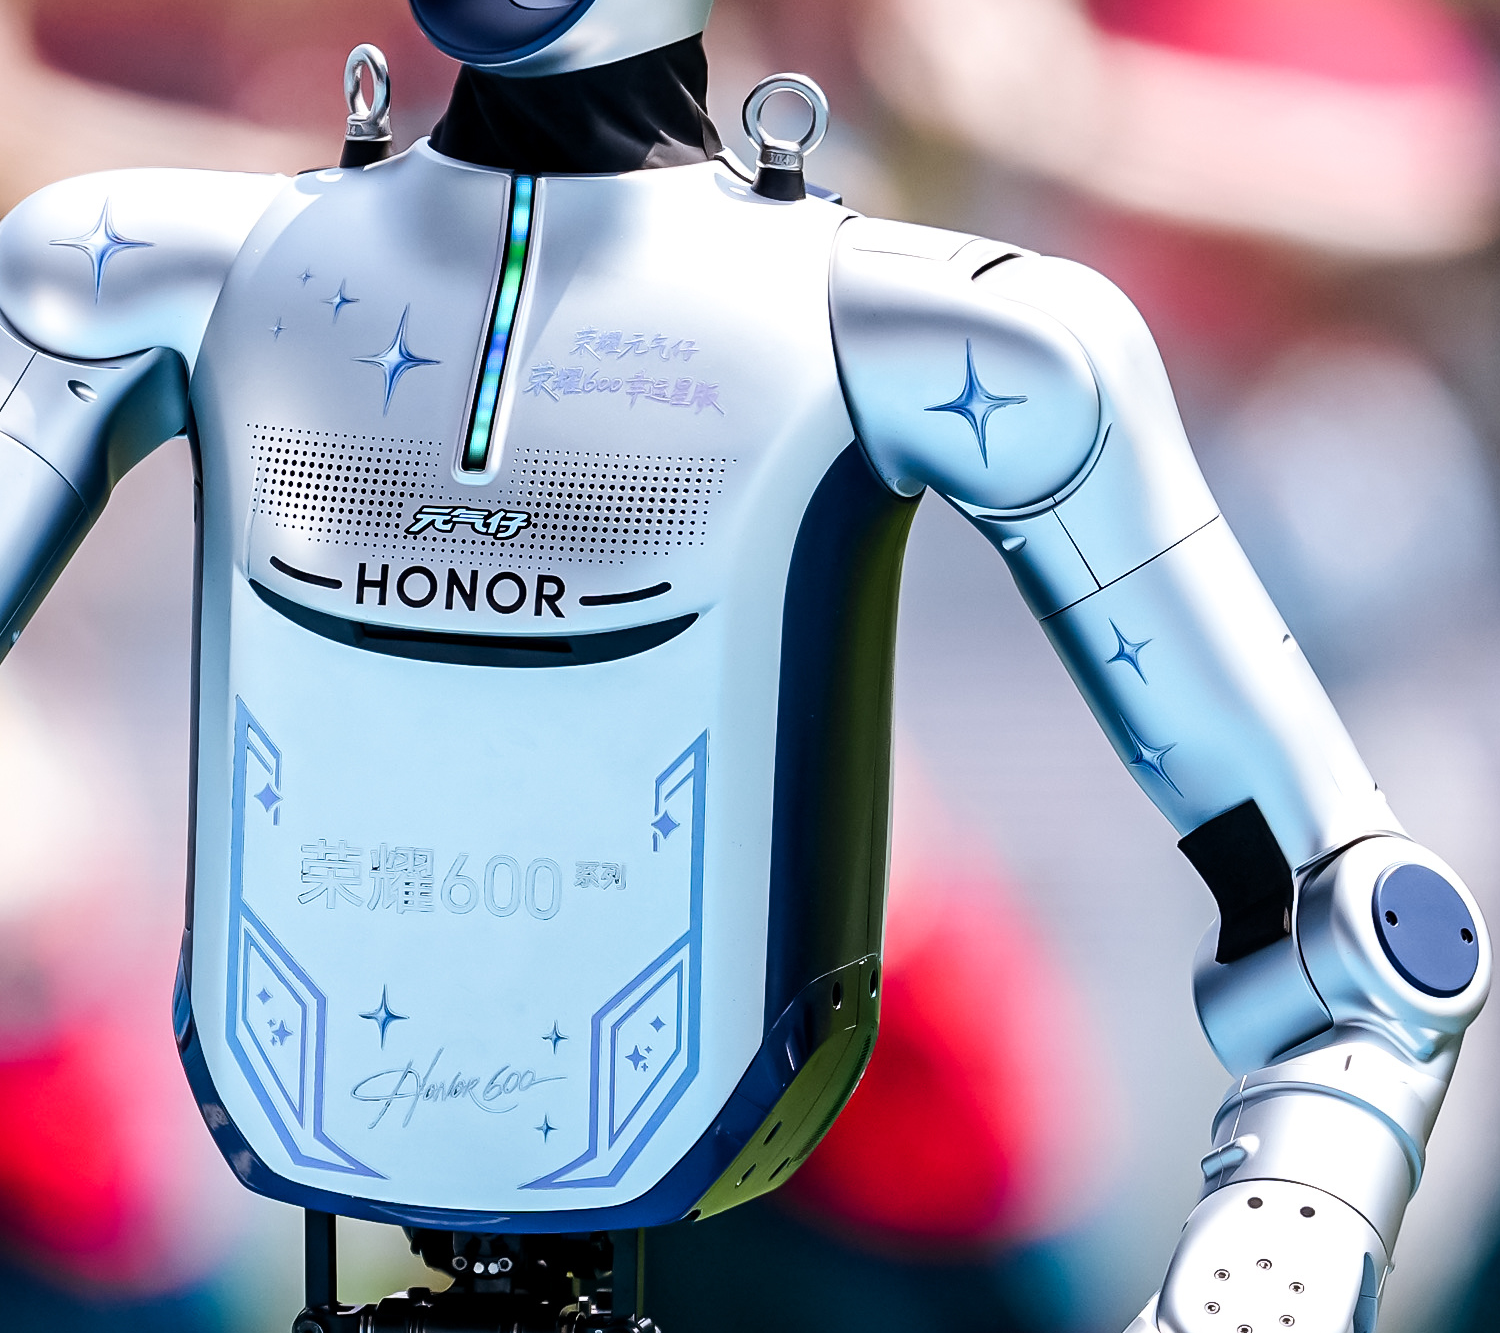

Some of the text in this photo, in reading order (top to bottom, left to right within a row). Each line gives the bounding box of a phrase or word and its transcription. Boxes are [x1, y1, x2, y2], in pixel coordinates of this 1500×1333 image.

[569, 326, 699, 361] 荣耀元气仔
[523, 361, 726, 416] 荣耀600幸运星版
[404, 505, 532, 540] 元气仔
[355, 562, 566, 618] HONOR
